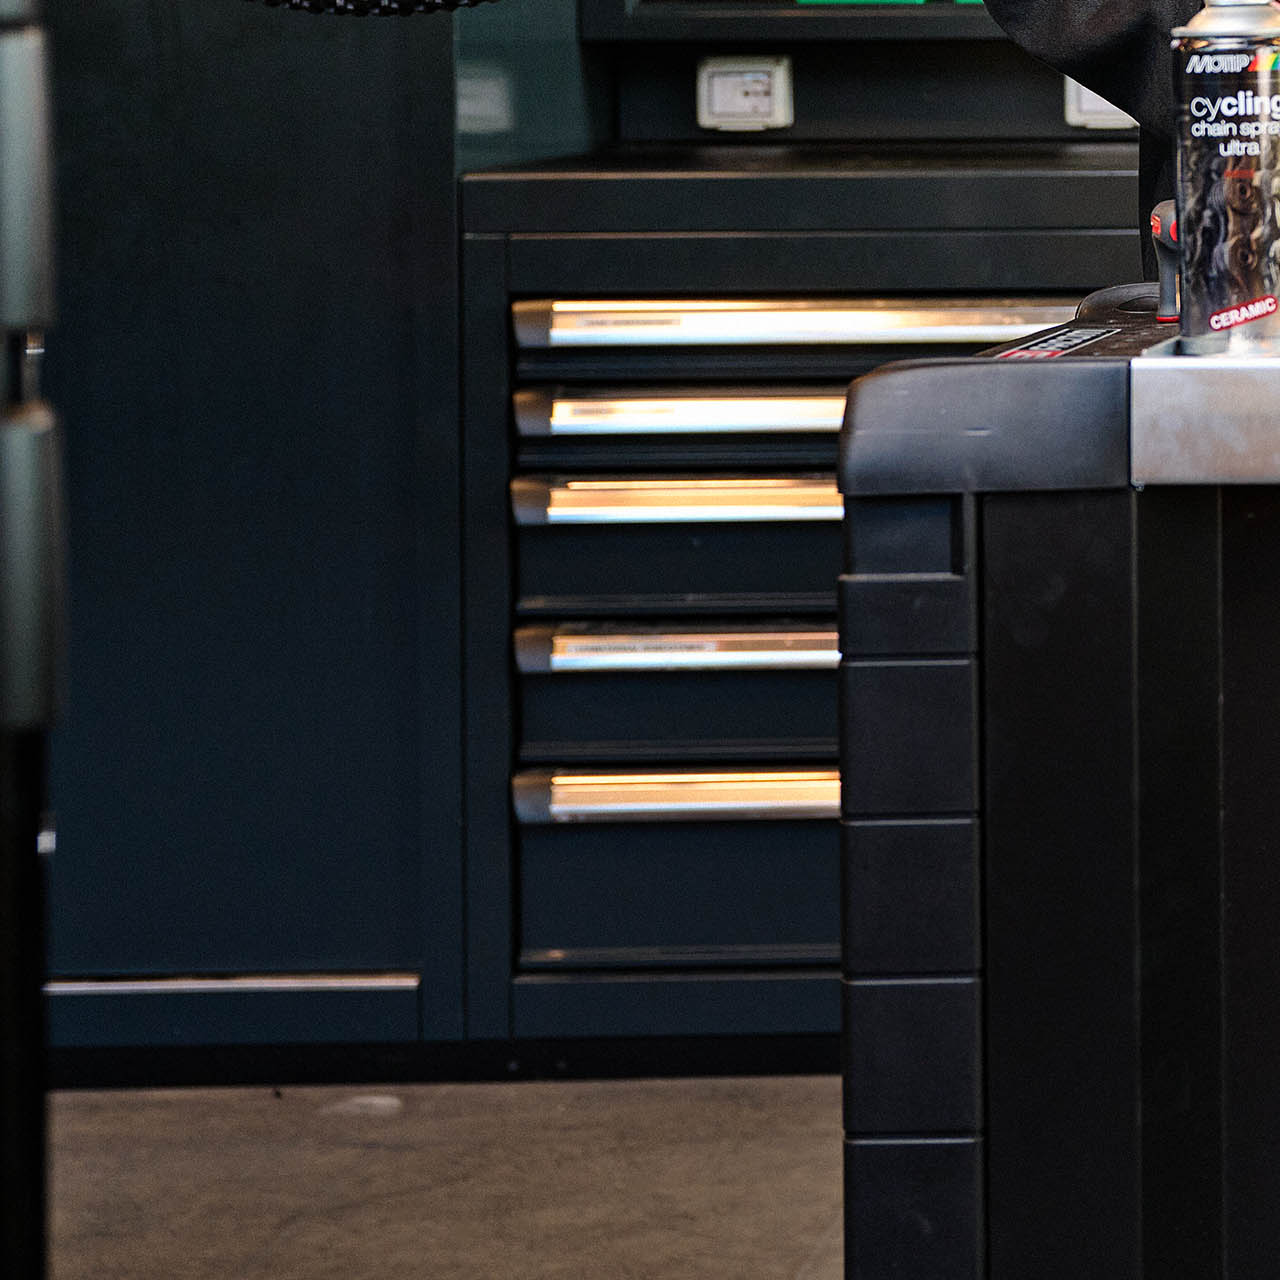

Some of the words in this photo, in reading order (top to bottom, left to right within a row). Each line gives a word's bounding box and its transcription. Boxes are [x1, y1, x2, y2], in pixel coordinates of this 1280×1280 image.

[1186, 54, 1250, 73] MOTIP
[1191, 120, 1238, 138] chain
[1219, 139, 1261, 157] ultra
[1210, 297, 1277, 330] CERAMIC
